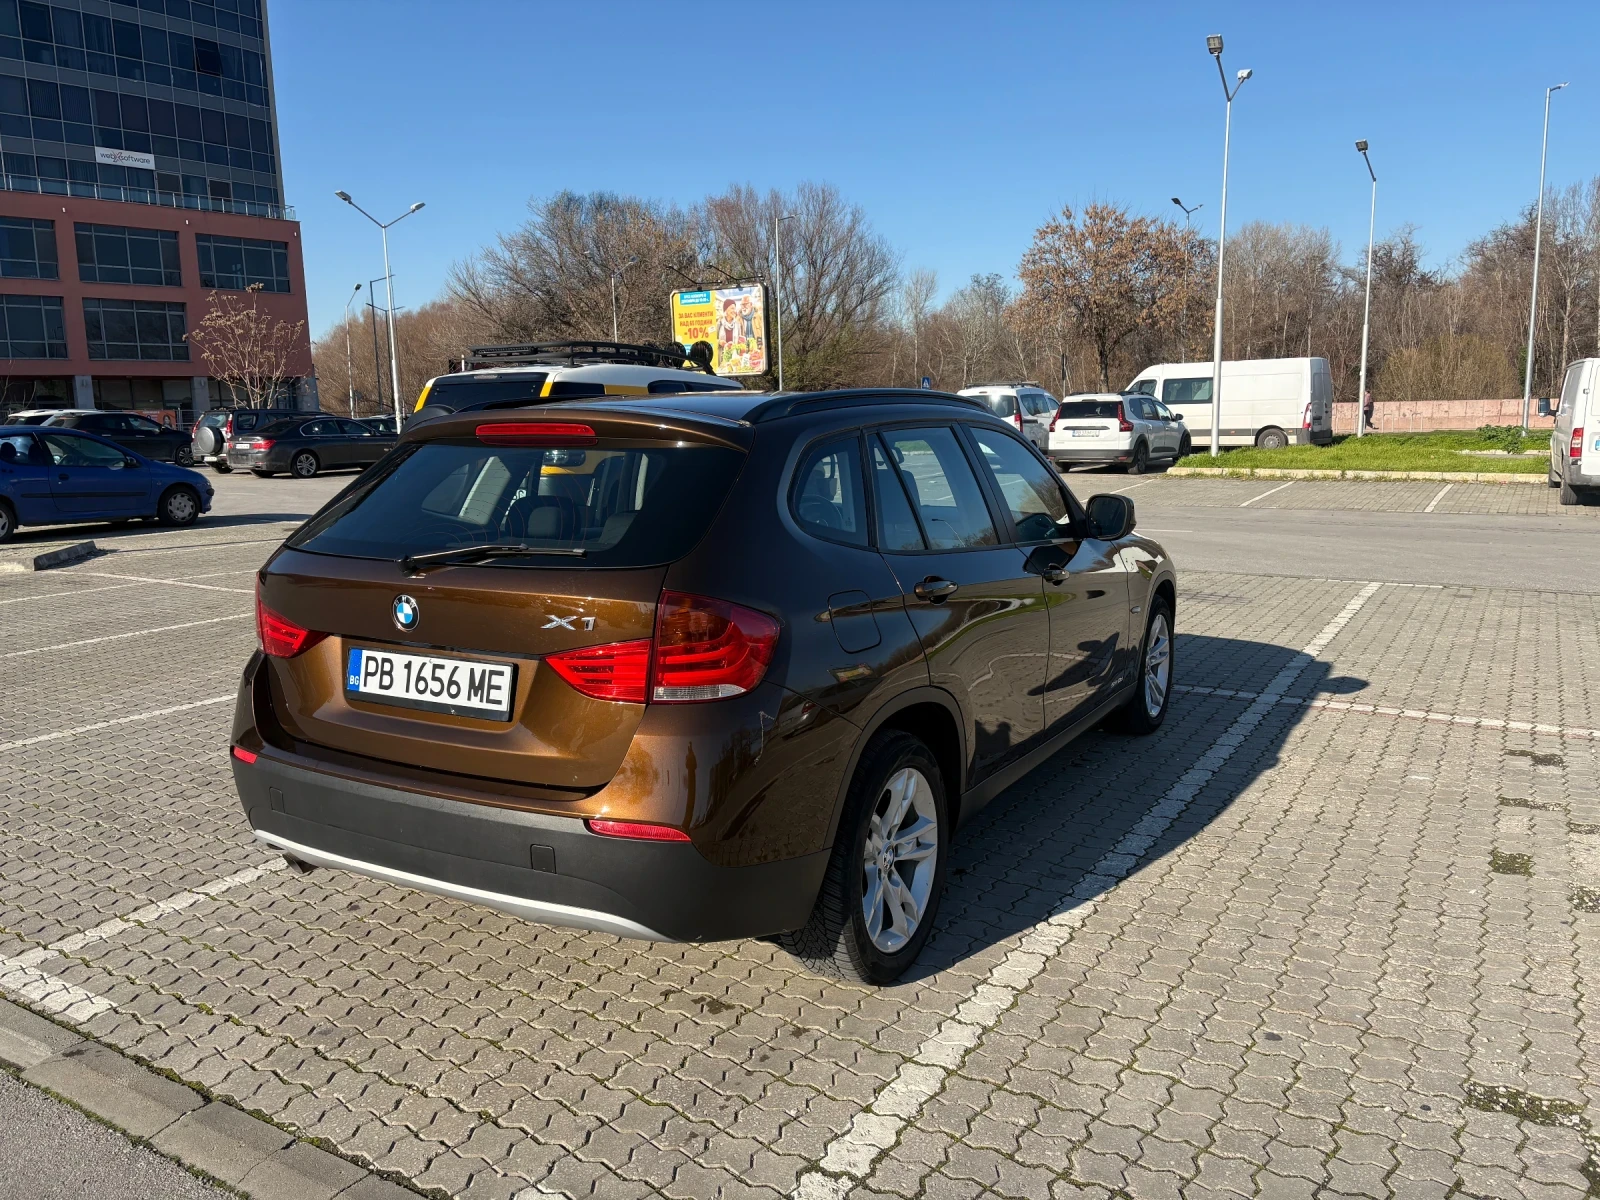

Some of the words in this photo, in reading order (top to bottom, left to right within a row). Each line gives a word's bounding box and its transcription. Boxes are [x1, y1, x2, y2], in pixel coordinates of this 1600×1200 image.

[684, 327, 709, 340] -10%
[540, 615, 596, 631] X1
[349, 675, 360, 686] BG
[363, 656, 394, 691] PB
[403, 660, 462, 700] 1656
[467, 667, 505, 706] ME
